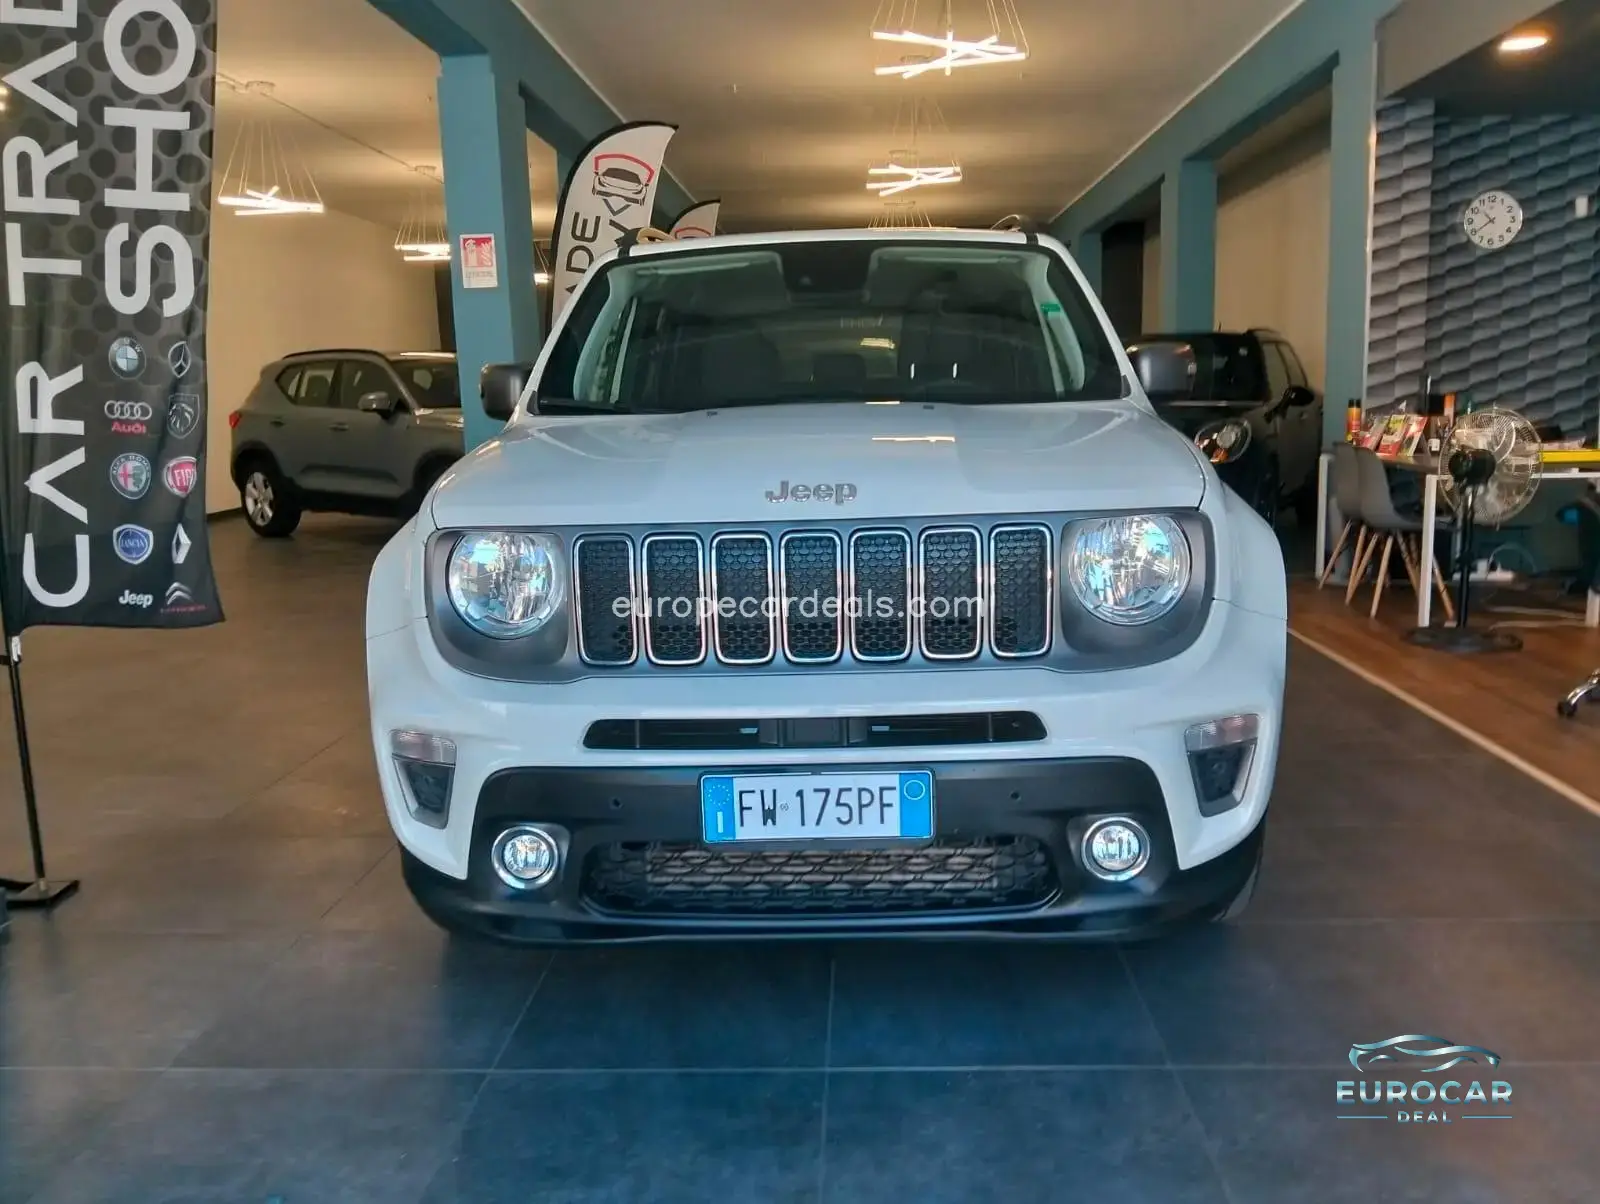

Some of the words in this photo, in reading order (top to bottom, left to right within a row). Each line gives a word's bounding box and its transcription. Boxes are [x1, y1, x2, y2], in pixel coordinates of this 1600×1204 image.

[565, 212, 601, 294] DE
[16, 361, 90, 607] CAR
[765, 481, 858, 505] Jeep
[119, 590, 153, 608] Jeep
[738, 788, 777, 827] FW
[795, 786, 897, 826] 175PF
